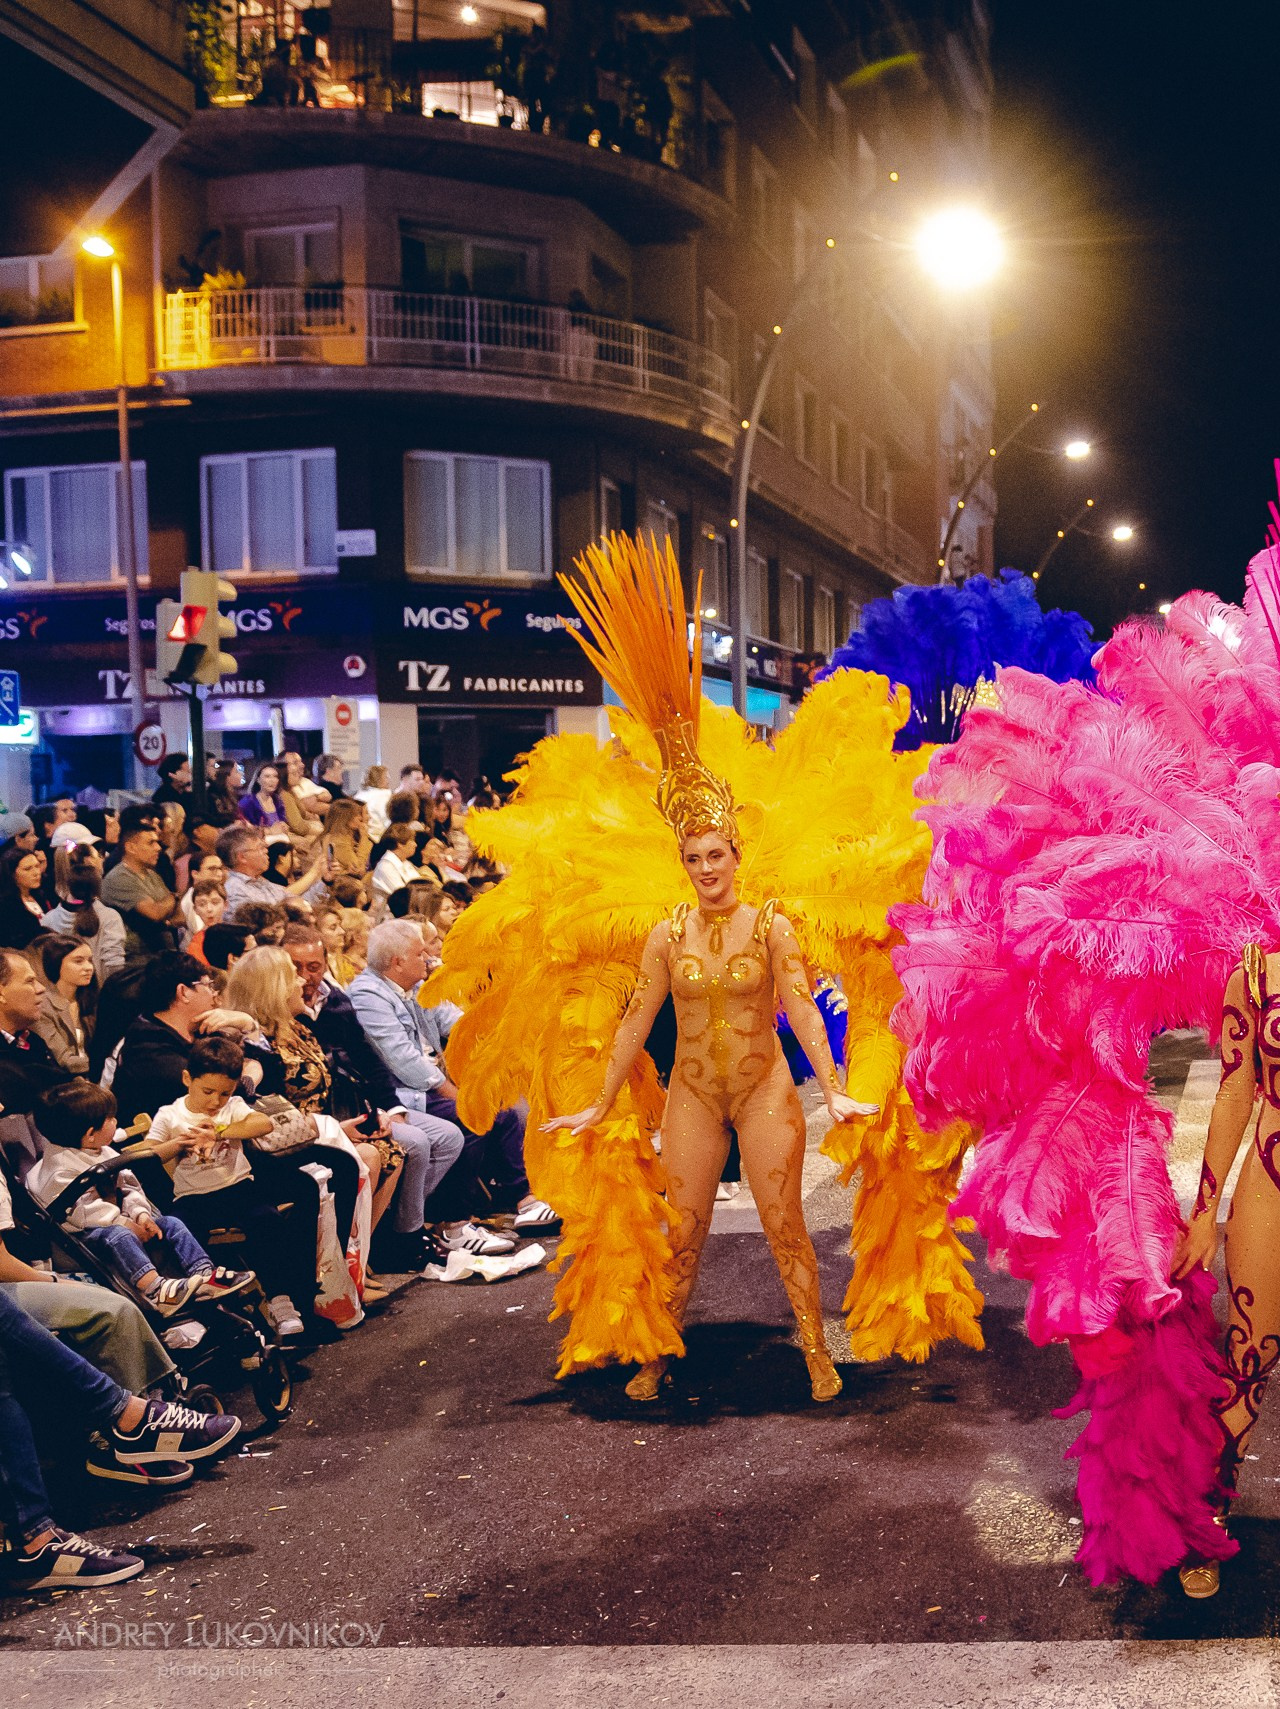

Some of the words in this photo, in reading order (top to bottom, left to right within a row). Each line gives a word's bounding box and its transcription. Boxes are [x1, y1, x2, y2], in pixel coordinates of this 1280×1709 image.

[403, 606, 470, 631] MGS
[398, 660, 451, 691] TZ
[463, 677, 585, 693] FABRICANTES
[142, 735, 160, 750] 20
